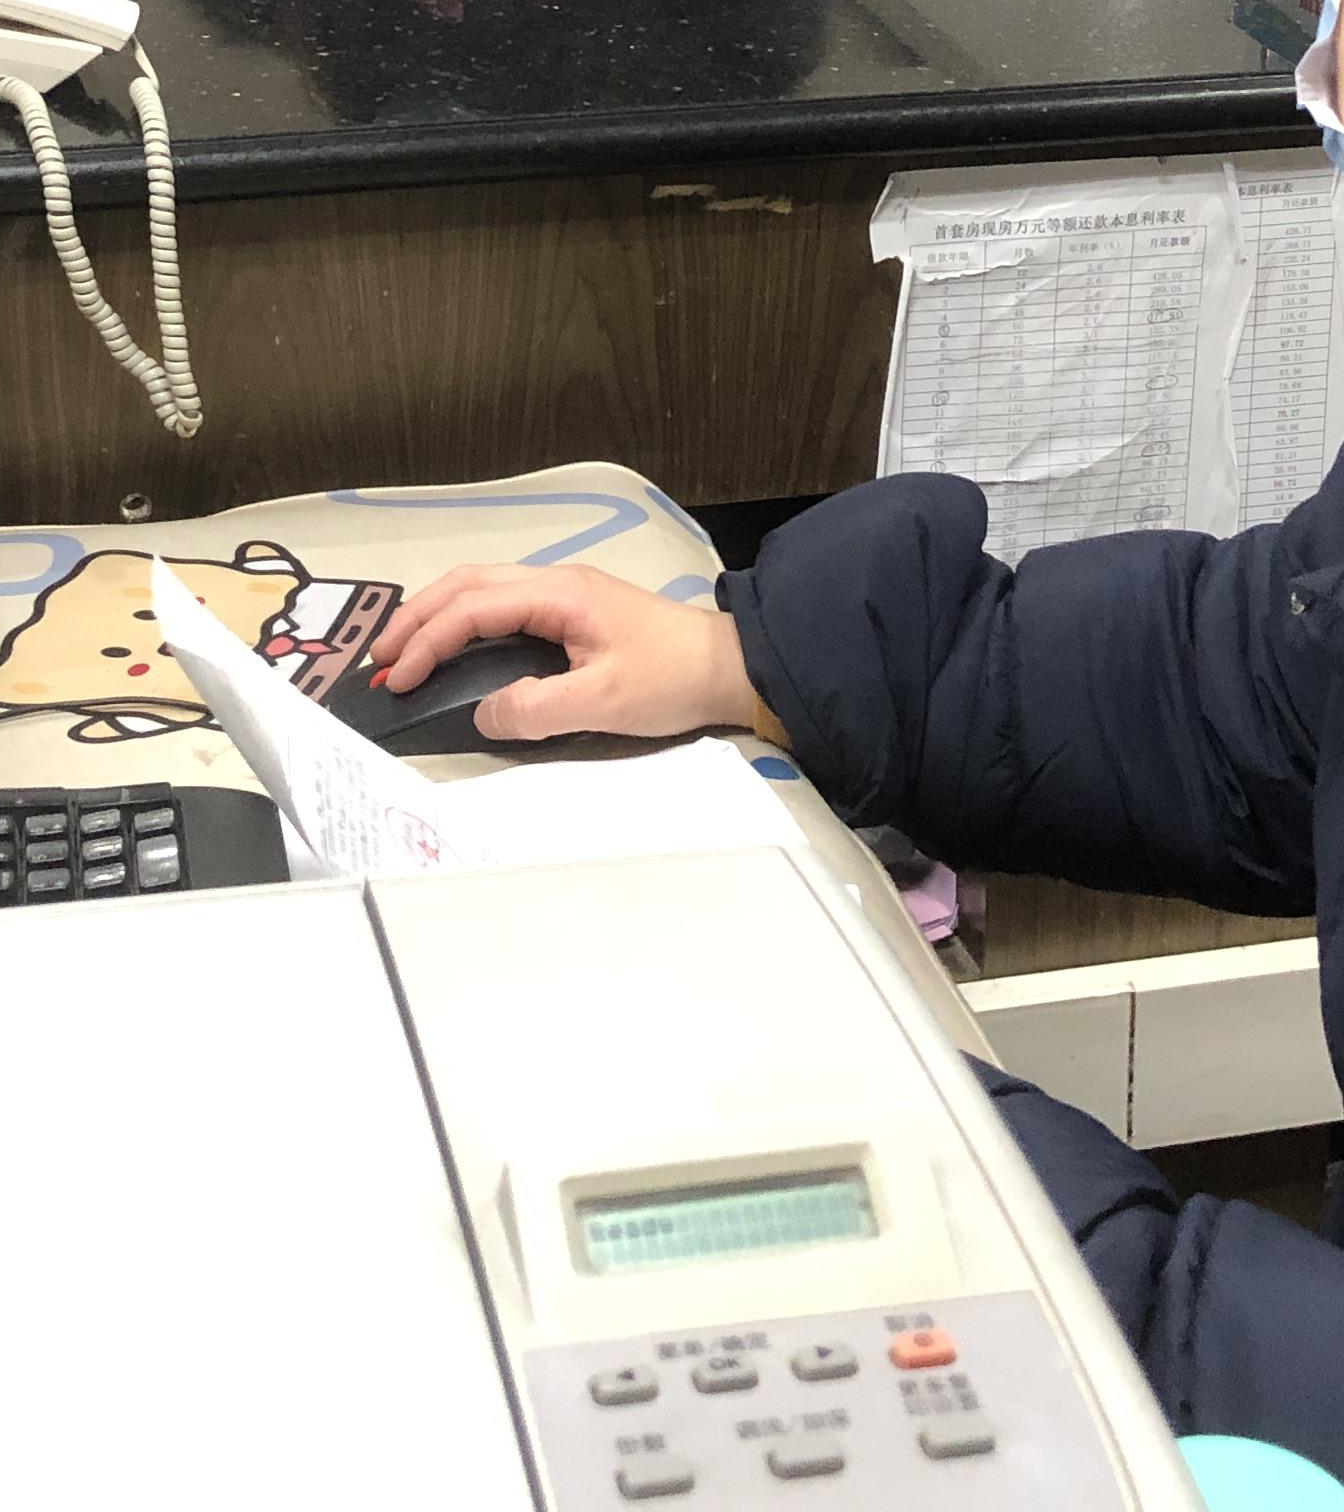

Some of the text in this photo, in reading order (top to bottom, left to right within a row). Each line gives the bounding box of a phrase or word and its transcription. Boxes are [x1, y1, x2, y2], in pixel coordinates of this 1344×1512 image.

[935, 209, 1186, 239] 首套房现房万元等额还款本息利率表
[709, 1356, 739, 1370] OK
